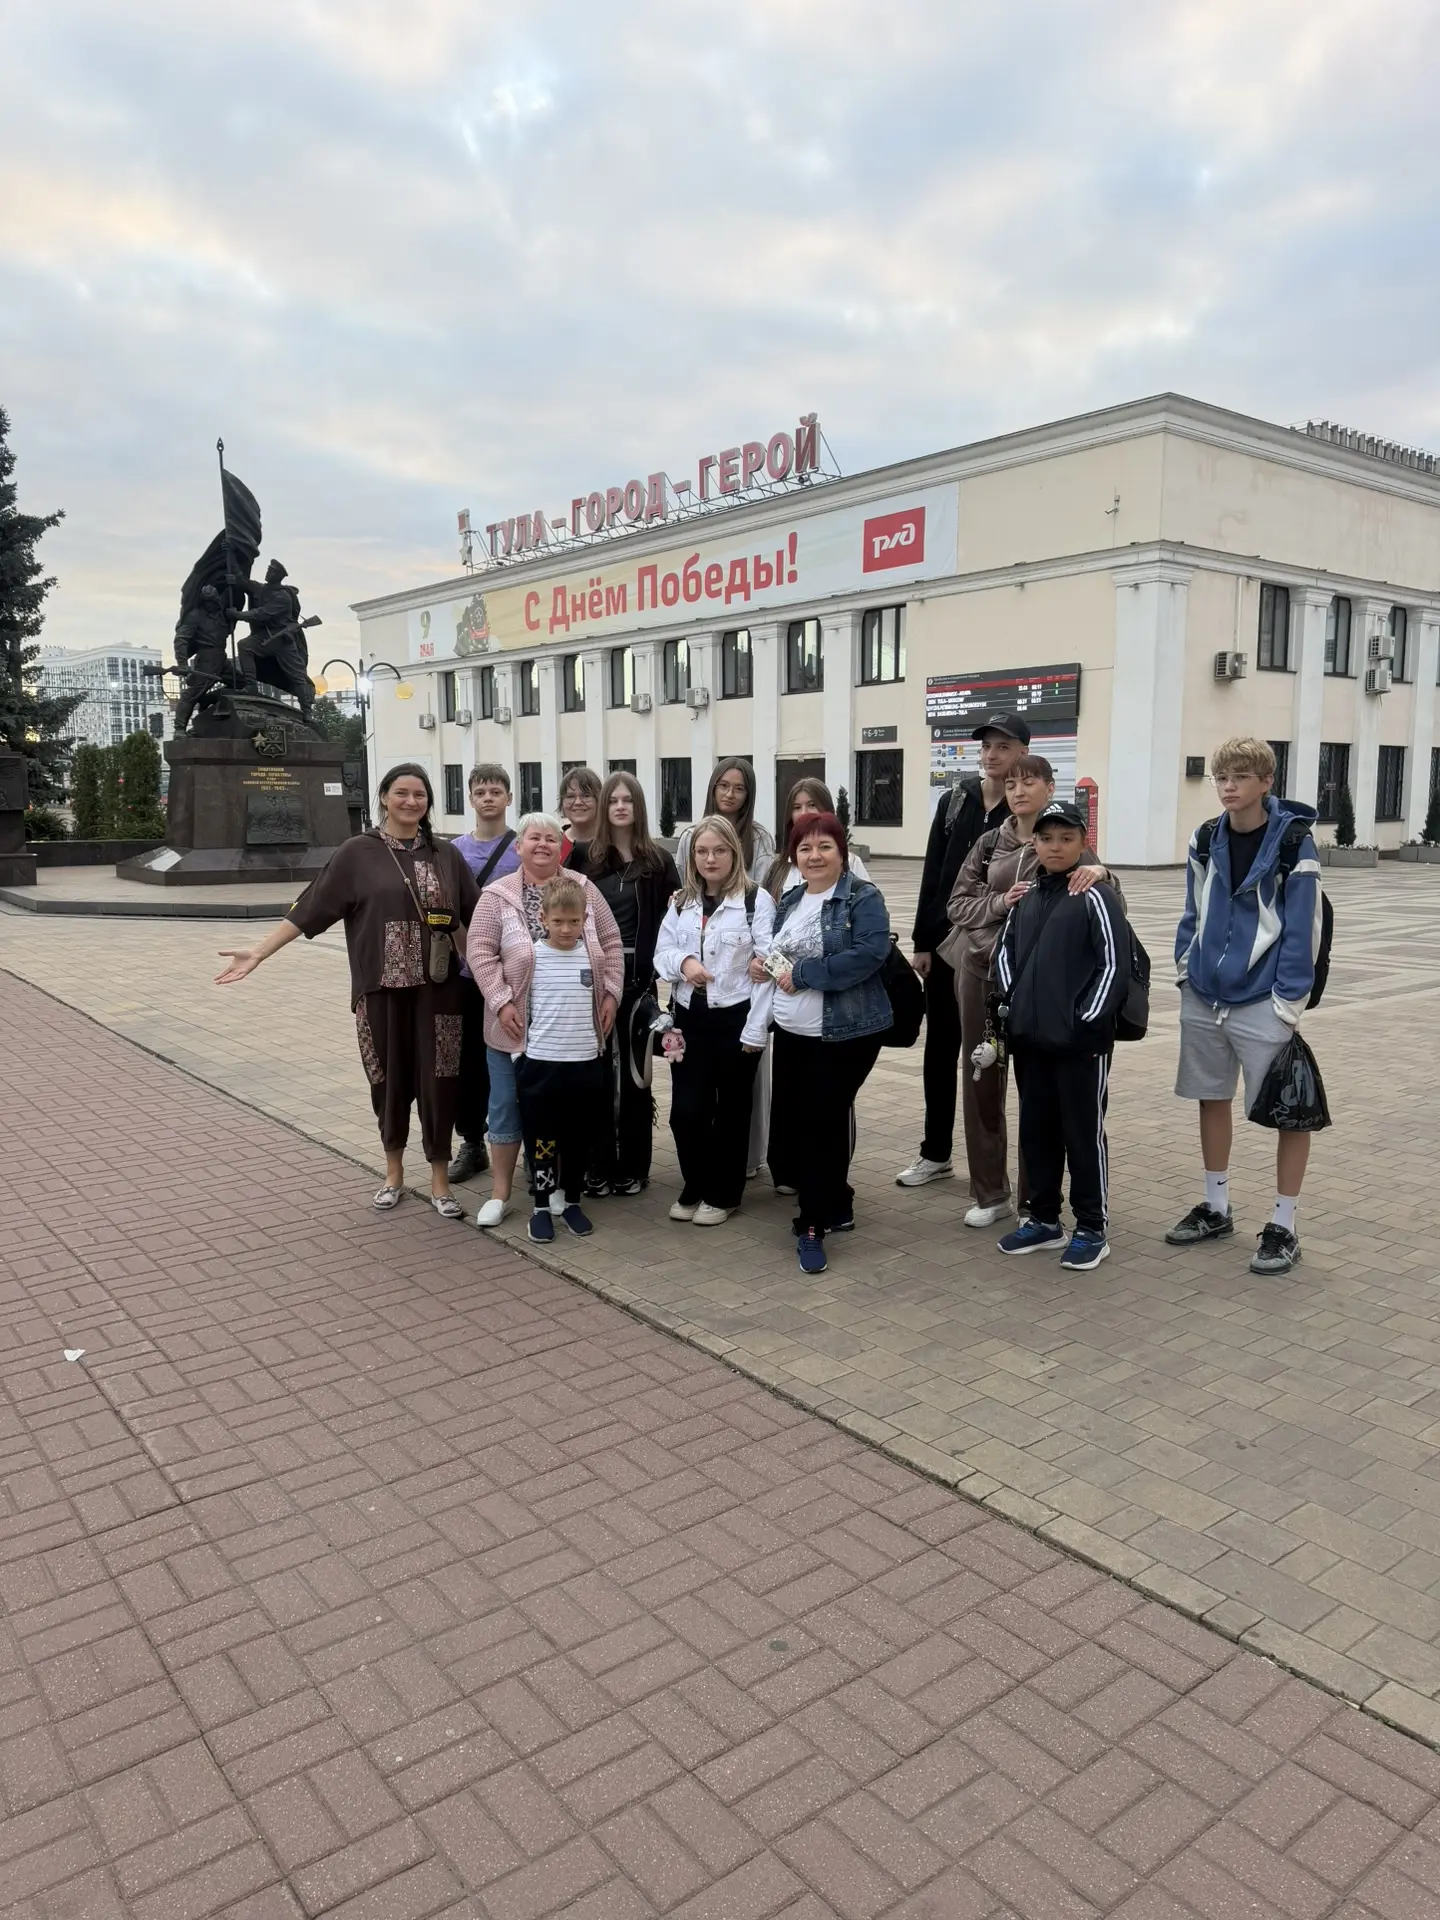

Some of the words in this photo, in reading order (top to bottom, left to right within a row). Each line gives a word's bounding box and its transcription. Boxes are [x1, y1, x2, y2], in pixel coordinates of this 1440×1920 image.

[524, 591, 541, 631] С
[548, 577, 628, 634] Днём
[637, 531, 798, 611] Победы!
[420, 610, 431, 639] 9
